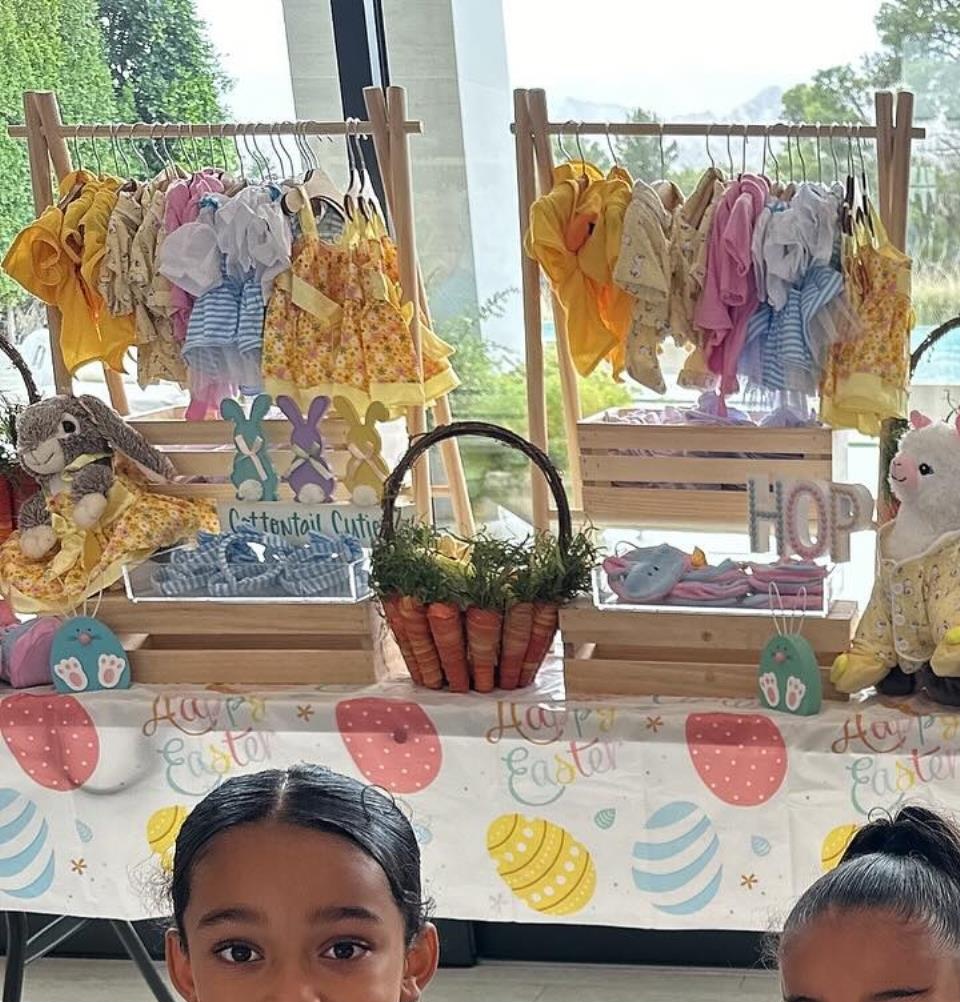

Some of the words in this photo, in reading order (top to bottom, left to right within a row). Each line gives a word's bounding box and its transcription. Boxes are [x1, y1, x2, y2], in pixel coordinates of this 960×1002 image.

[331, 509, 383, 539] Cutie
[748, 477, 876, 562] HOP
[486, 700, 616, 746] Happy
[831, 713, 960, 754] Happy
[157, 726, 275, 797] Easter
[501, 736, 623, 807] Easter
[846, 745, 958, 816] Easter
